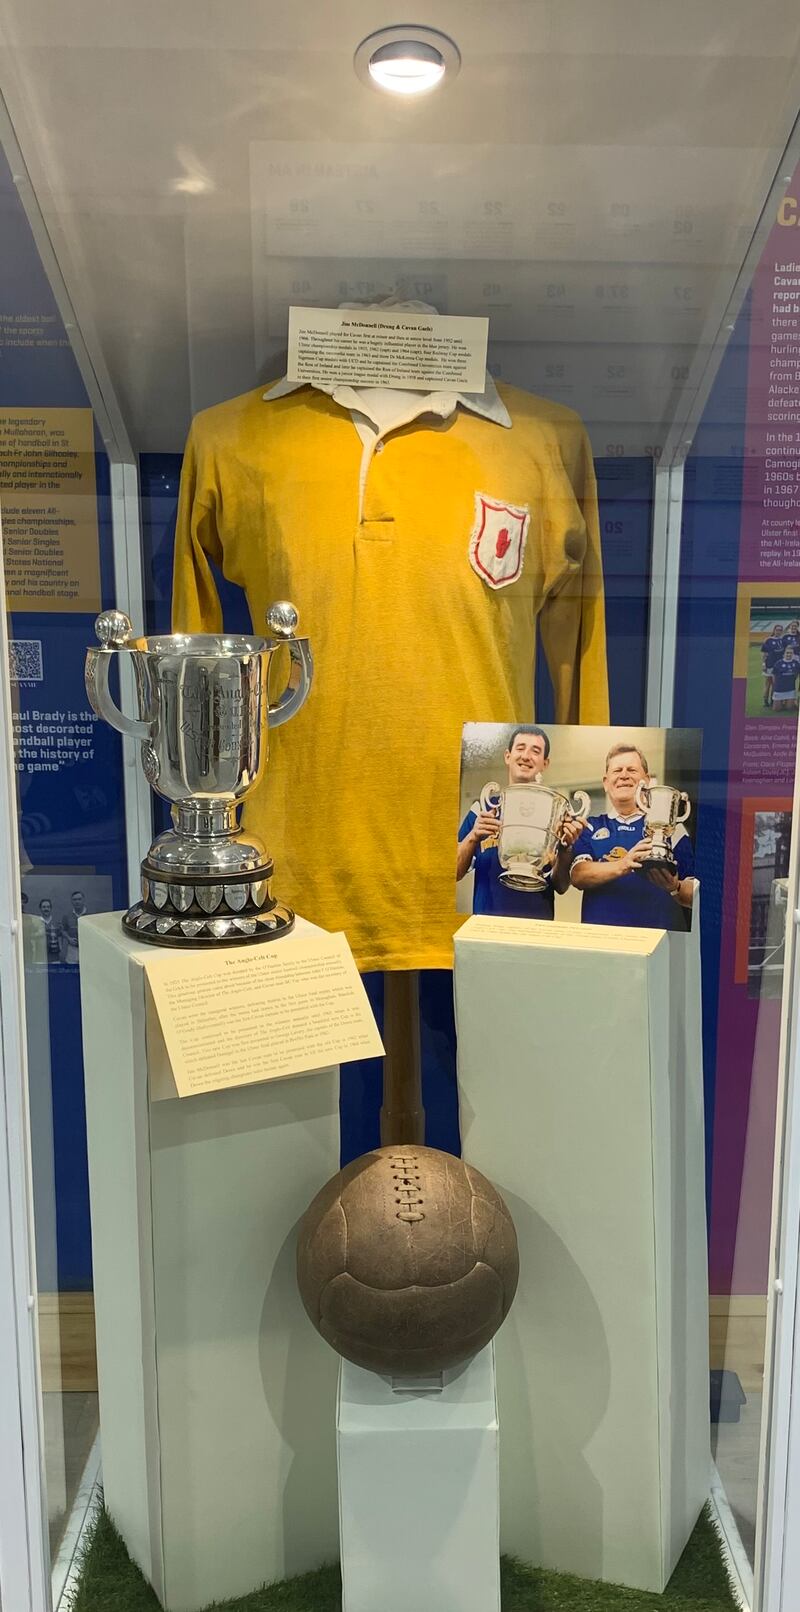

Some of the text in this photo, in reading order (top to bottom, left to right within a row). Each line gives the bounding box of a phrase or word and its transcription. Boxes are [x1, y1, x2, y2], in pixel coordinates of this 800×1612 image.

[777, 197, 800, 227] C
[775, 262, 800, 272] Ladie
[773, 292, 800, 302] repor
[772, 304, 791, 313] had
[772, 317, 797, 327] there
[770, 344, 800, 356] hurlin
[770, 358, 800, 369] champ
[769, 371, 792, 381] from
[769, 385, 800, 394] Alacke
[766, 432, 793, 442] In the
[23, 450, 43, 458] John
[765, 445, 800, 455] continu
[765, 459, 800, 470] Camog
[765, 472, 794, 481] 1960s
[14, 481, 38, 490] player
[48, 481, 61, 489] the
[775, 485, 798, 494] 1967
[3, 527, 60, 536] Senior Doubles
[7, 538, 32, 546] Senior
[8, 548, 65, 556] Senior Doubles
[12, 710, 99, 723] aul Brady is the
[12, 723, 94, 735] ost decorated
[13, 735, 93, 749] andball player
[19, 748, 95, 761] the history of
